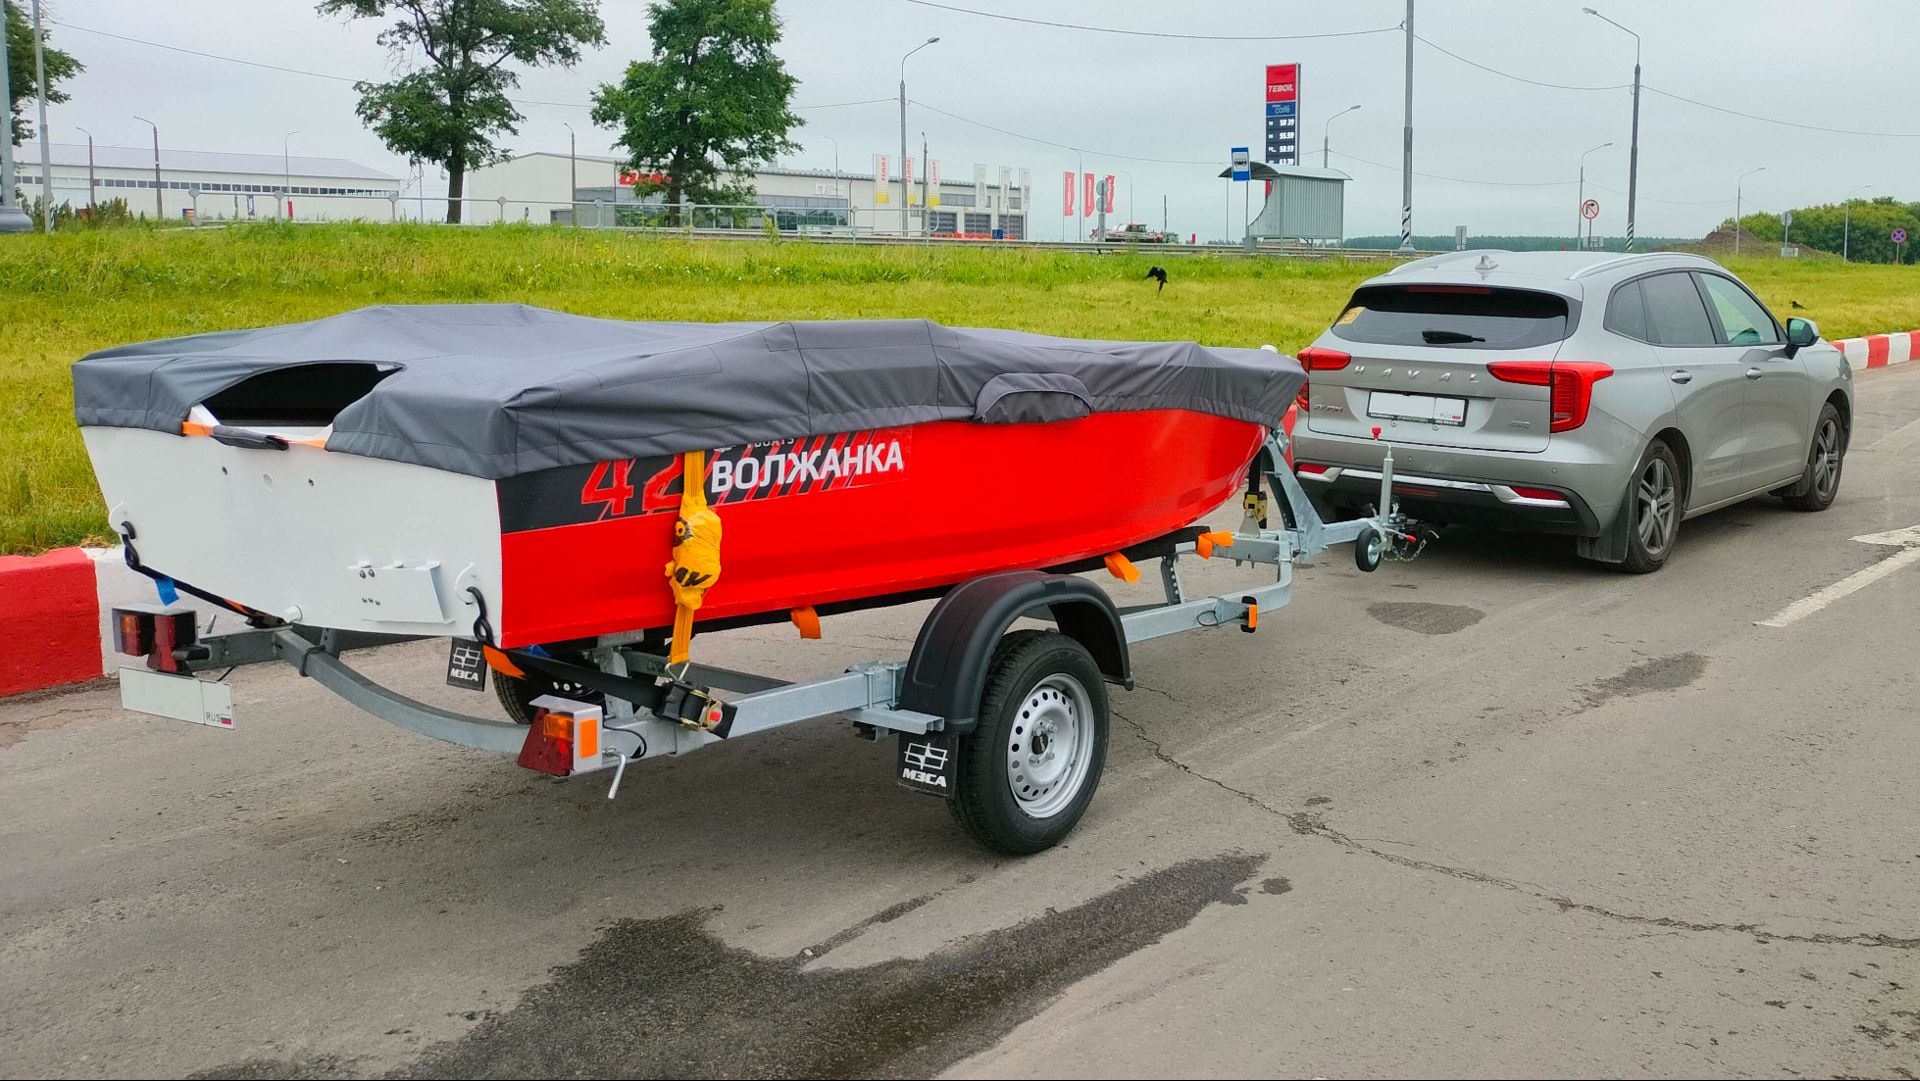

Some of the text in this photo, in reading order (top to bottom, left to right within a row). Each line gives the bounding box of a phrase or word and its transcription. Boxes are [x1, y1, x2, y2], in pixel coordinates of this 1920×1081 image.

[1268, 84, 1294, 93] TEBOIL
[1354, 365, 1480, 383] HAVAL
[711, 441, 904, 493] ВОЛЖАНКА
[450, 667, 479, 682] МЗСА
[205, 711, 221, 722] RUS
[902, 767, 947, 788] МЗСА
